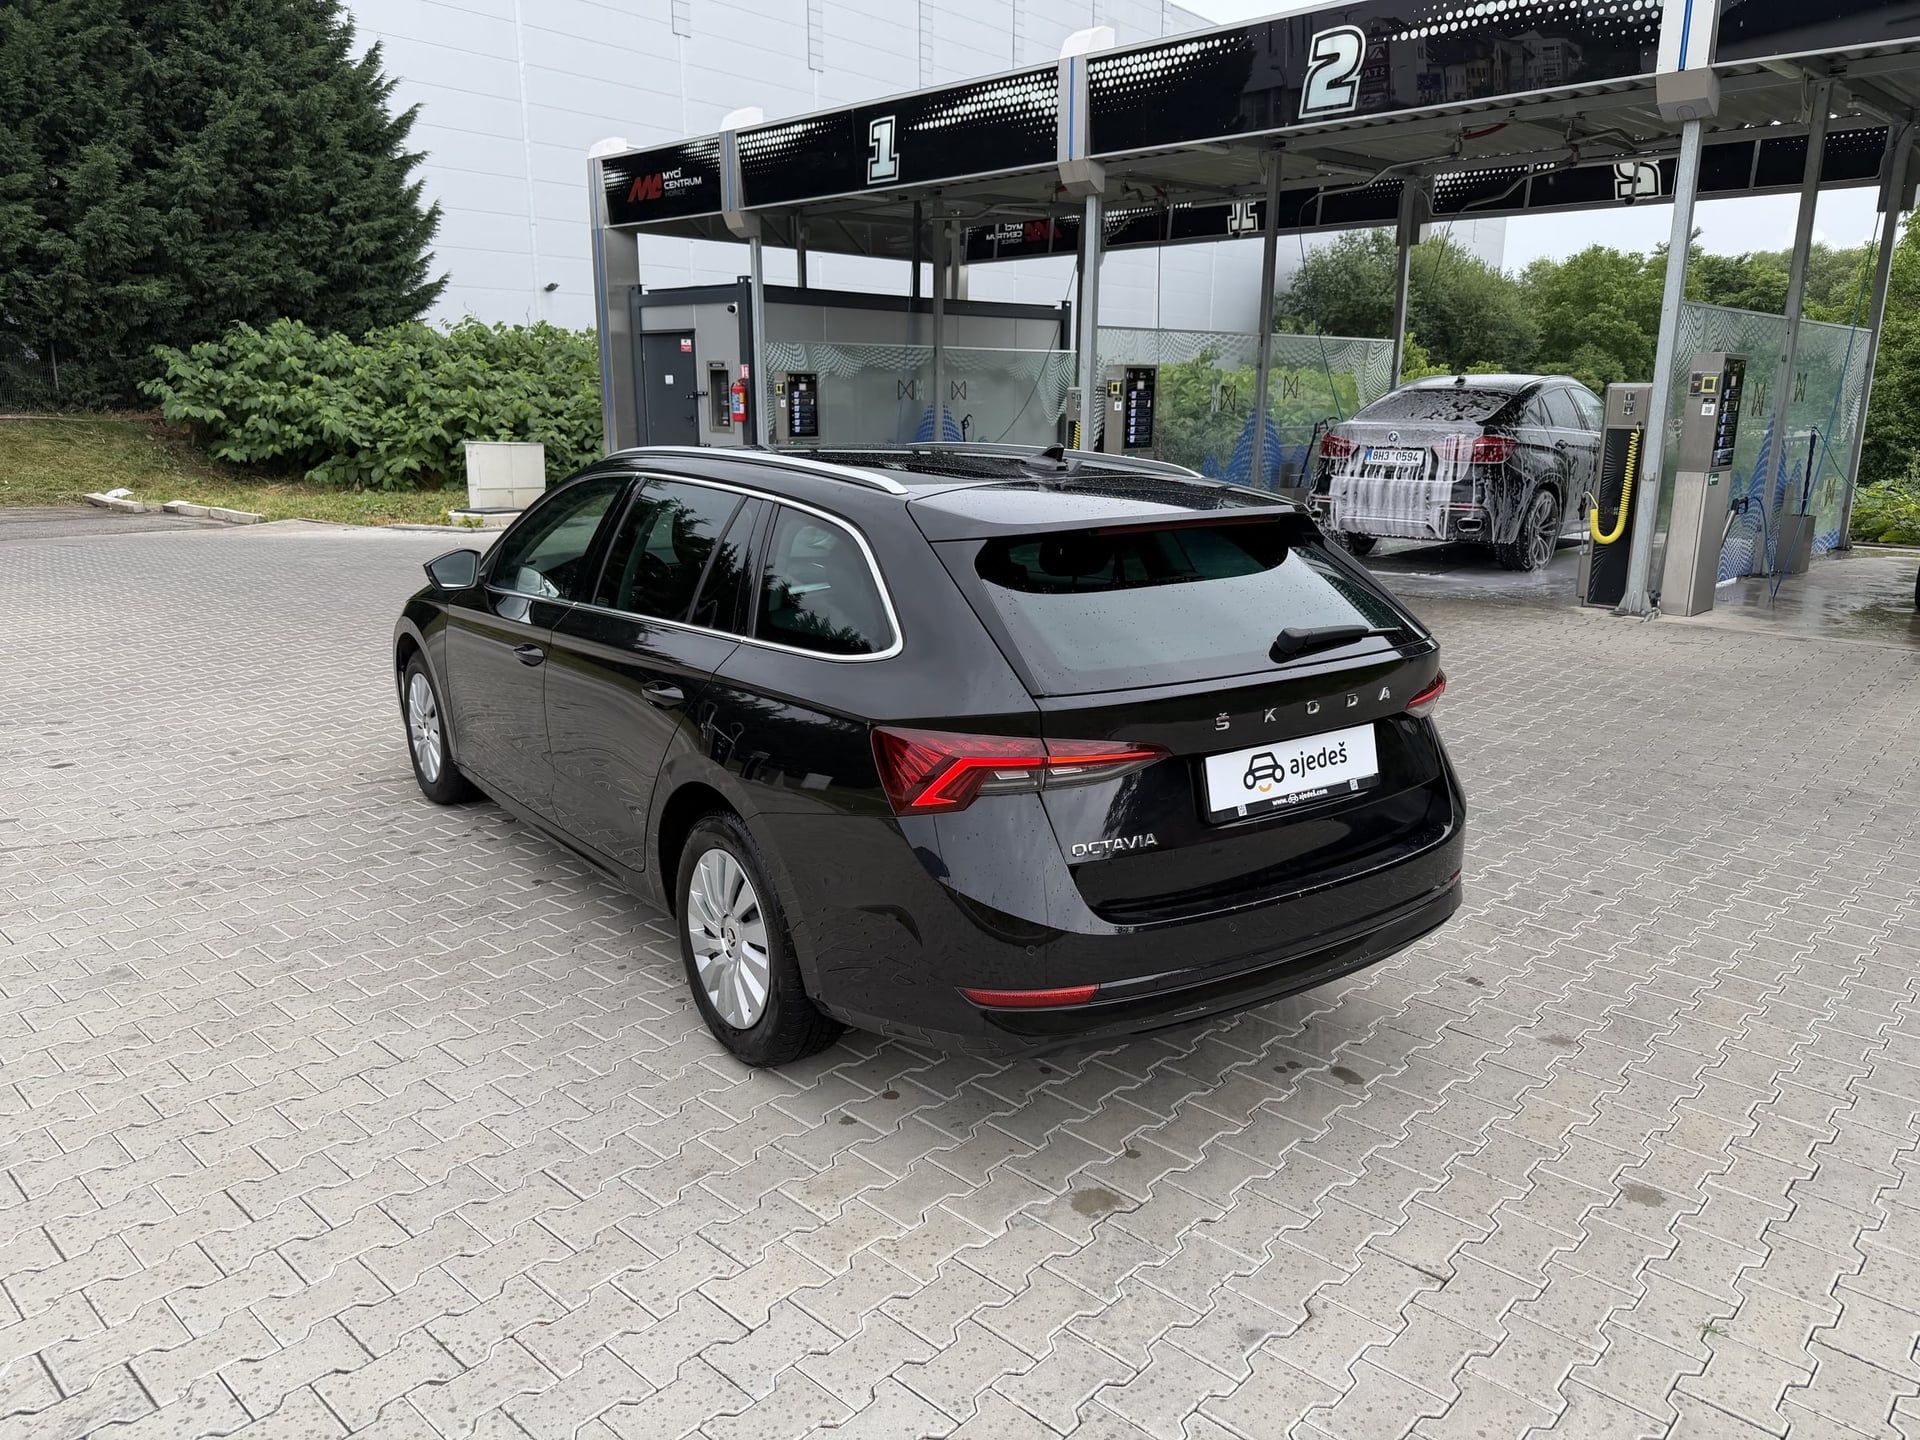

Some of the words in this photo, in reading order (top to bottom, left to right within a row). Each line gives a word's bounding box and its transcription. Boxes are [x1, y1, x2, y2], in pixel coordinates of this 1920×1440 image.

[1298, 24, 1366, 119] 2
[867, 115, 900, 185] 1
[663, 176, 702, 189] CENTRUM
[1372, 450, 1389, 460] 8H3
[1395, 451, 1418, 461] 0594
[1214, 686, 1392, 731] ŠKODA
[1289, 741, 1348, 778] ajedeš
[1071, 832, 1159, 858] OCTAVIA
